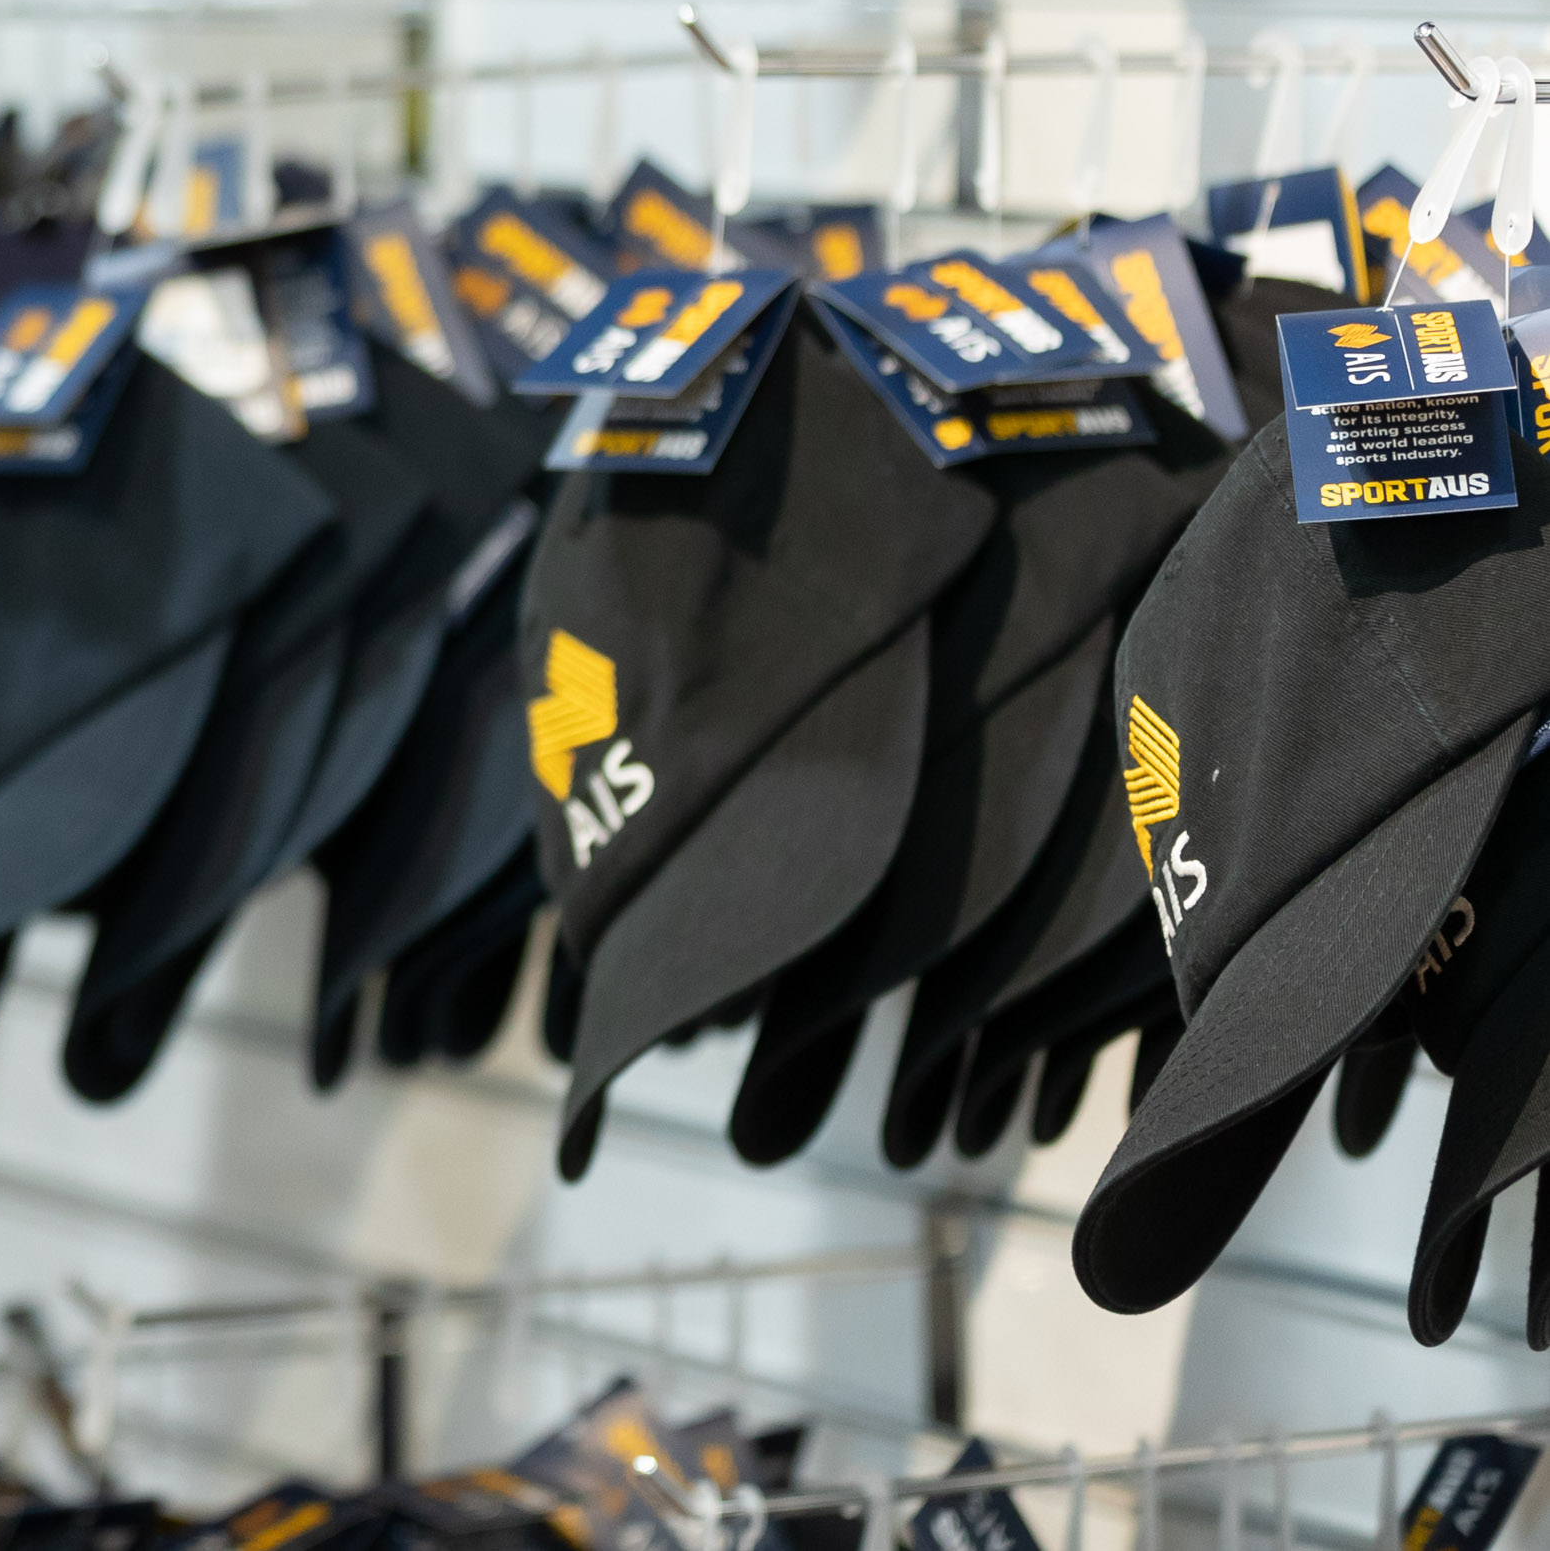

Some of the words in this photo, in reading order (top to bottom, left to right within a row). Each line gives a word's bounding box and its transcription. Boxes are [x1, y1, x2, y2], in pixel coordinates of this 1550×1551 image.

[1410, 311, 1468, 384] SPORTAUS
[1344, 353, 1391, 385] AIS
[1310, 405, 1360, 416] active
[1365, 400, 1422, 411] nation,
[1426, 394, 1479, 407] known
[1333, 416, 1357, 427] for
[1362, 413, 1382, 424] its
[1386, 409, 1460, 424] integrity,
[1330, 424, 1399, 441] sporting
[1404, 421, 1466, 435] success
[1326, 442, 1357, 454] and
[1361, 437, 1408, 450] world
[1413, 433, 1474, 447] leading
[1335, 451, 1388, 466] sports
[1392, 447, 1462, 462] industry.
[1320, 473, 1490, 507] SPORTAUS
[565, 737, 655, 869] AIS
